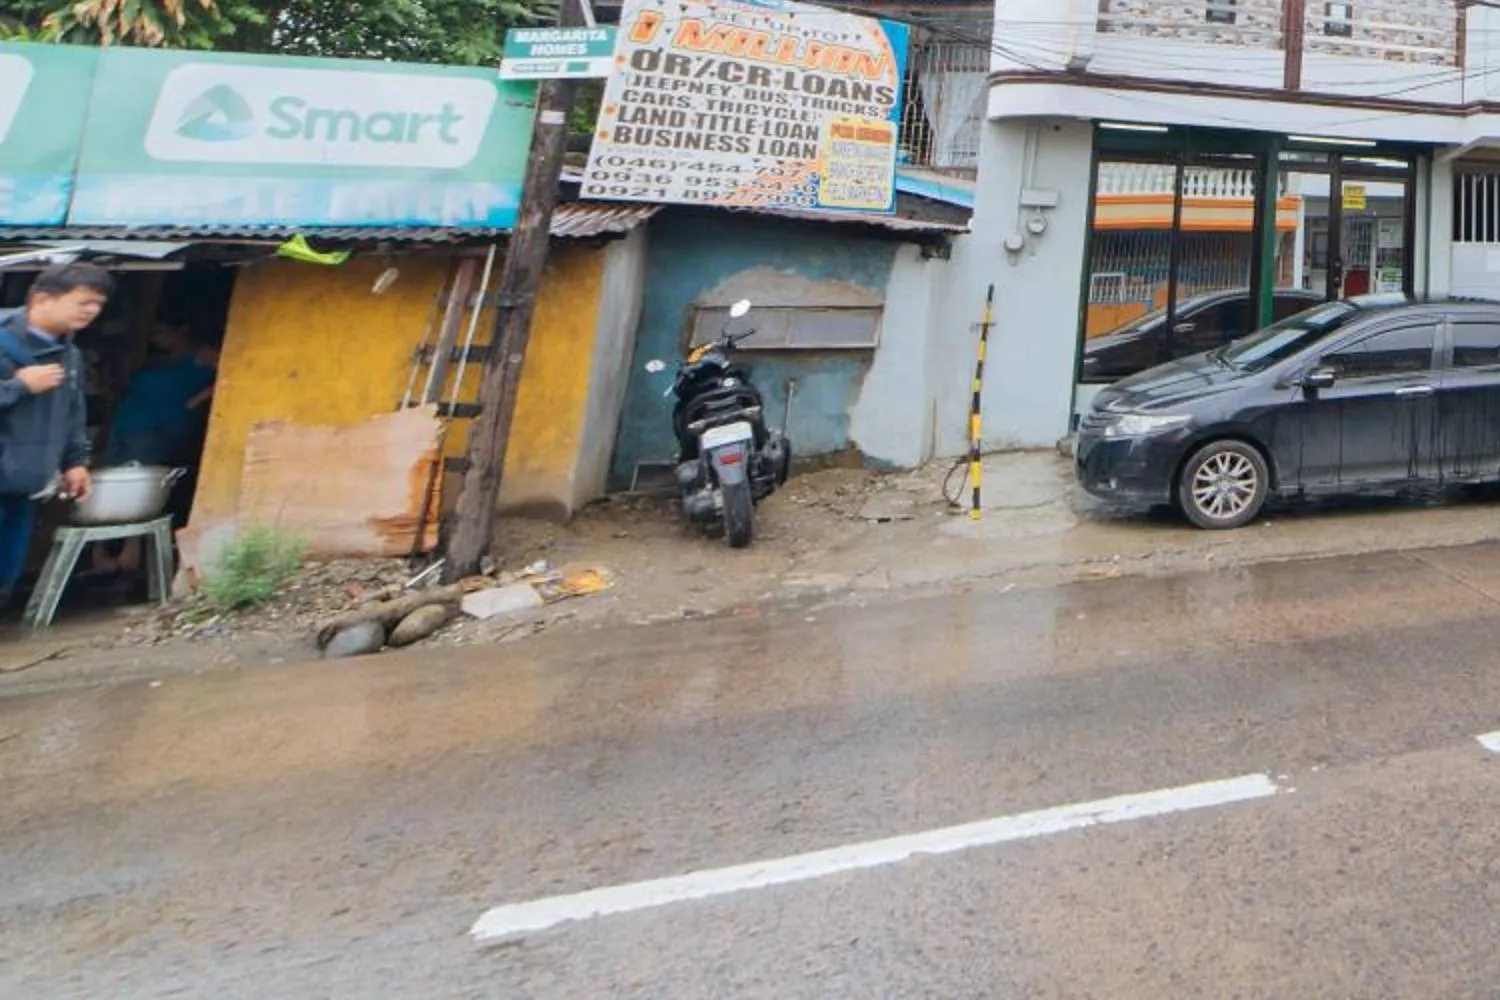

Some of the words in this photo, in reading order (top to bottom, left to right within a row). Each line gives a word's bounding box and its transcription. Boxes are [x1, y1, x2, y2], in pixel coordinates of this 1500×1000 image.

[514, 30, 607, 42] MARGARITA
[530, 43, 587, 56] HOMES
[672, 17, 892, 81] MILLION
[631, 49, 772, 87] OR/CR
[783, 71, 894, 105] LOANS
[264, 94, 463, 145] Smart
[618, 105, 686, 127] LAND
[695, 113, 755, 135] TITLE
[763, 119, 819, 141] LOAN
[613, 126, 750, 154] BUSINESS
[757, 138, 817, 159] LOAN
[595, 155, 677, 172] (046)
[588, 184, 666, 197] 0921
[591, 171, 672, 185] 0936
